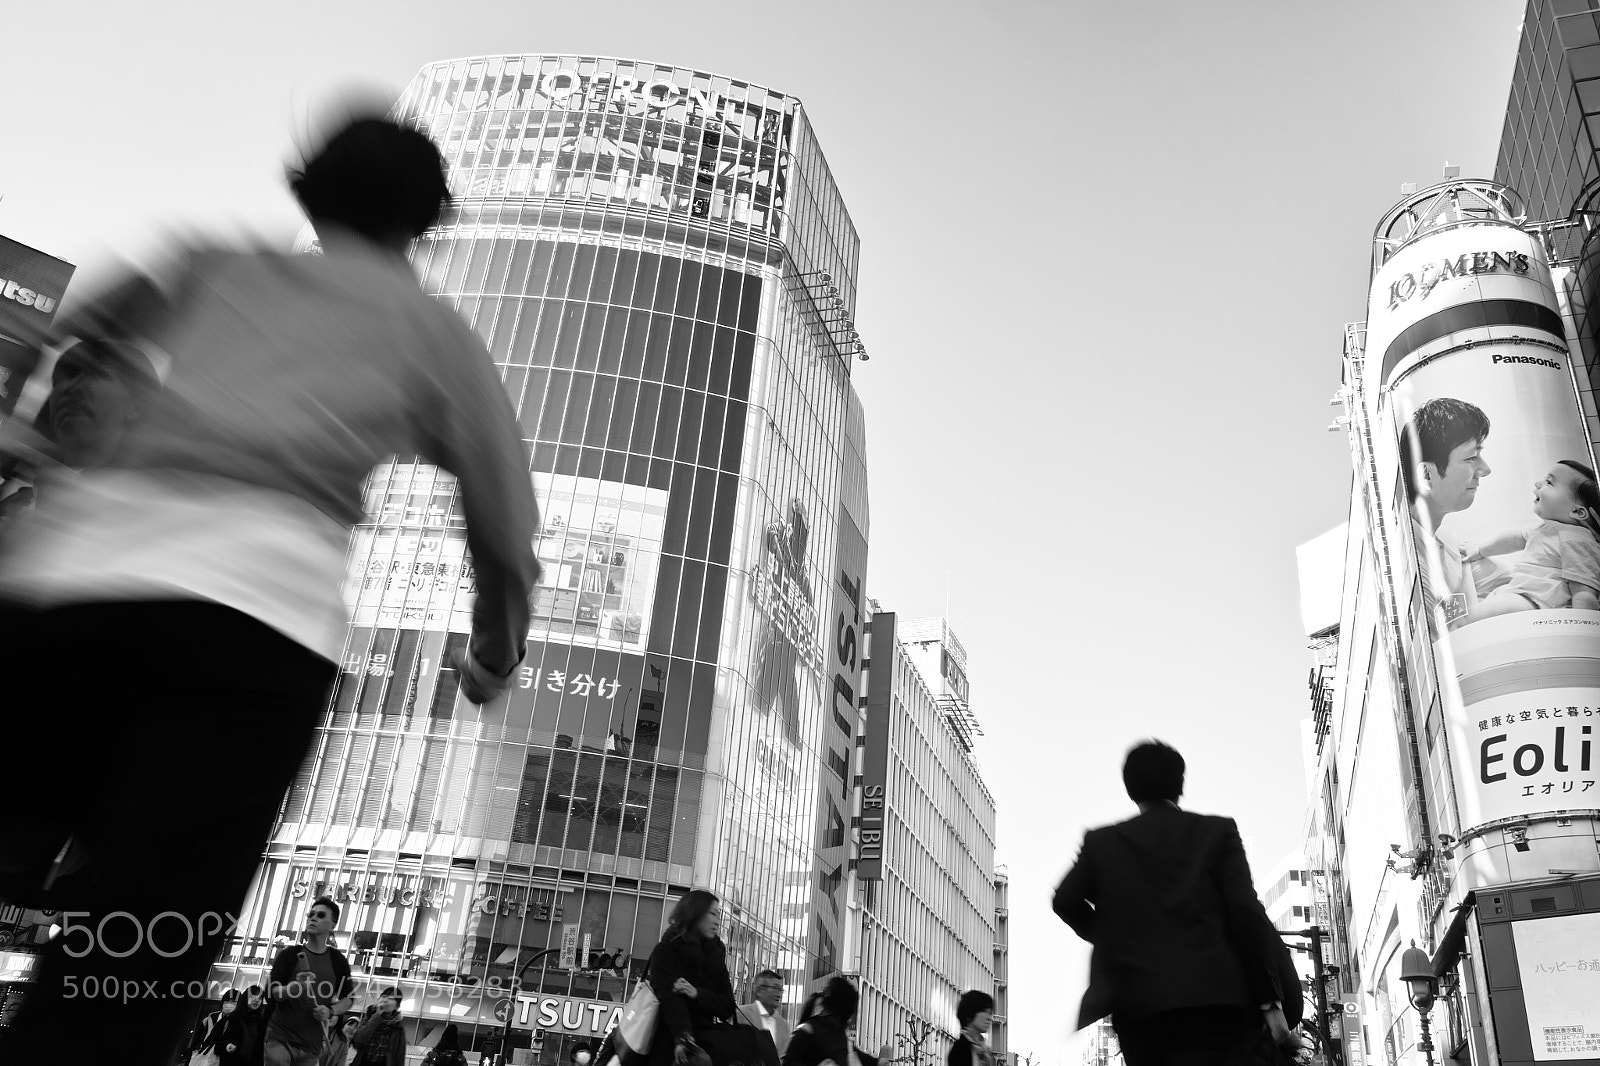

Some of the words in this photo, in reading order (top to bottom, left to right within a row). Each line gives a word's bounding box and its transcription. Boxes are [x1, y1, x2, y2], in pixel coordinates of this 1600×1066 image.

[1492, 354, 1562, 371] Panasonic
[376, 503, 467, 526] デコホー
[519, 666, 622, 700] 引き分け
[1480, 725, 1592, 785] Eoli
[813, 569, 861, 980] TSUTAYA
[1521, 780, 1596, 797] エオリア
[861, 784, 883, 860] SEIBU
[292, 880, 452, 908] STARBUCKS
[471, 893, 565, 923] COFFEE
